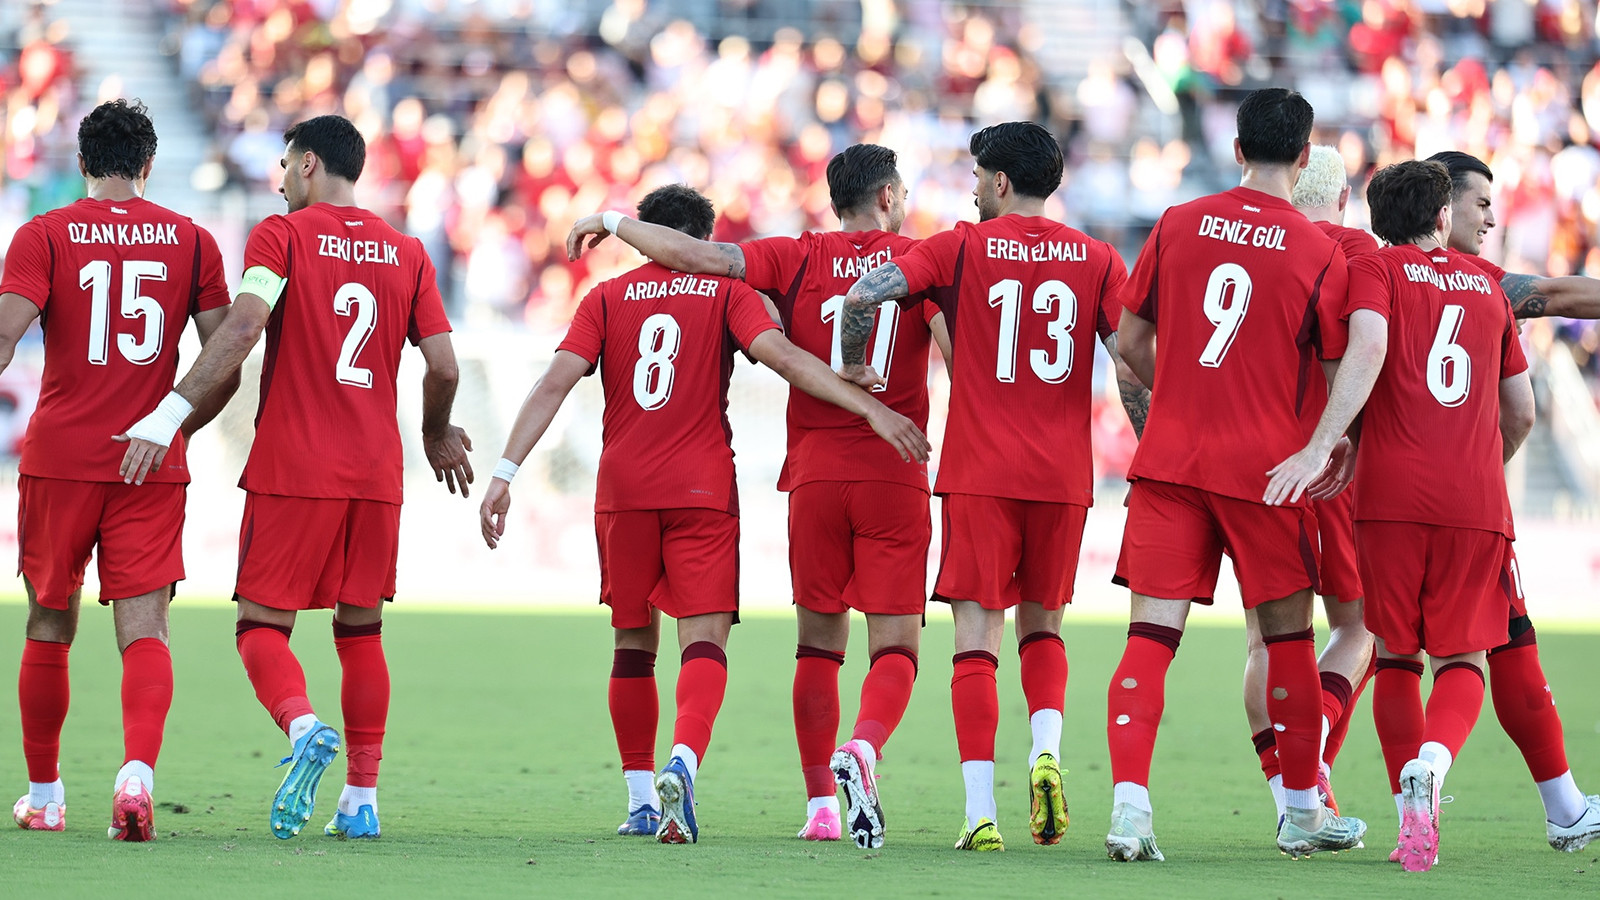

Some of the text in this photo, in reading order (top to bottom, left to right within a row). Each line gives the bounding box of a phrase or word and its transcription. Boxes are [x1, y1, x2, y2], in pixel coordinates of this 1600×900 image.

[68, 222, 179, 246] OZAN KABAK
[317, 234, 400, 266] ZEKİ ÇELİK
[987, 238, 1087, 262] EREN ELMALI
[1198, 215, 1286, 251] DENİZ GÜL
[79, 260, 167, 366] 15
[333, 282, 378, 389] 2
[623, 274, 719, 301] ARDA GÜLER
[988, 278, 1077, 384] 13
[1198, 262, 1252, 368] 9
[633, 313, 681, 411] 8
[1426, 304, 1471, 408] 6
